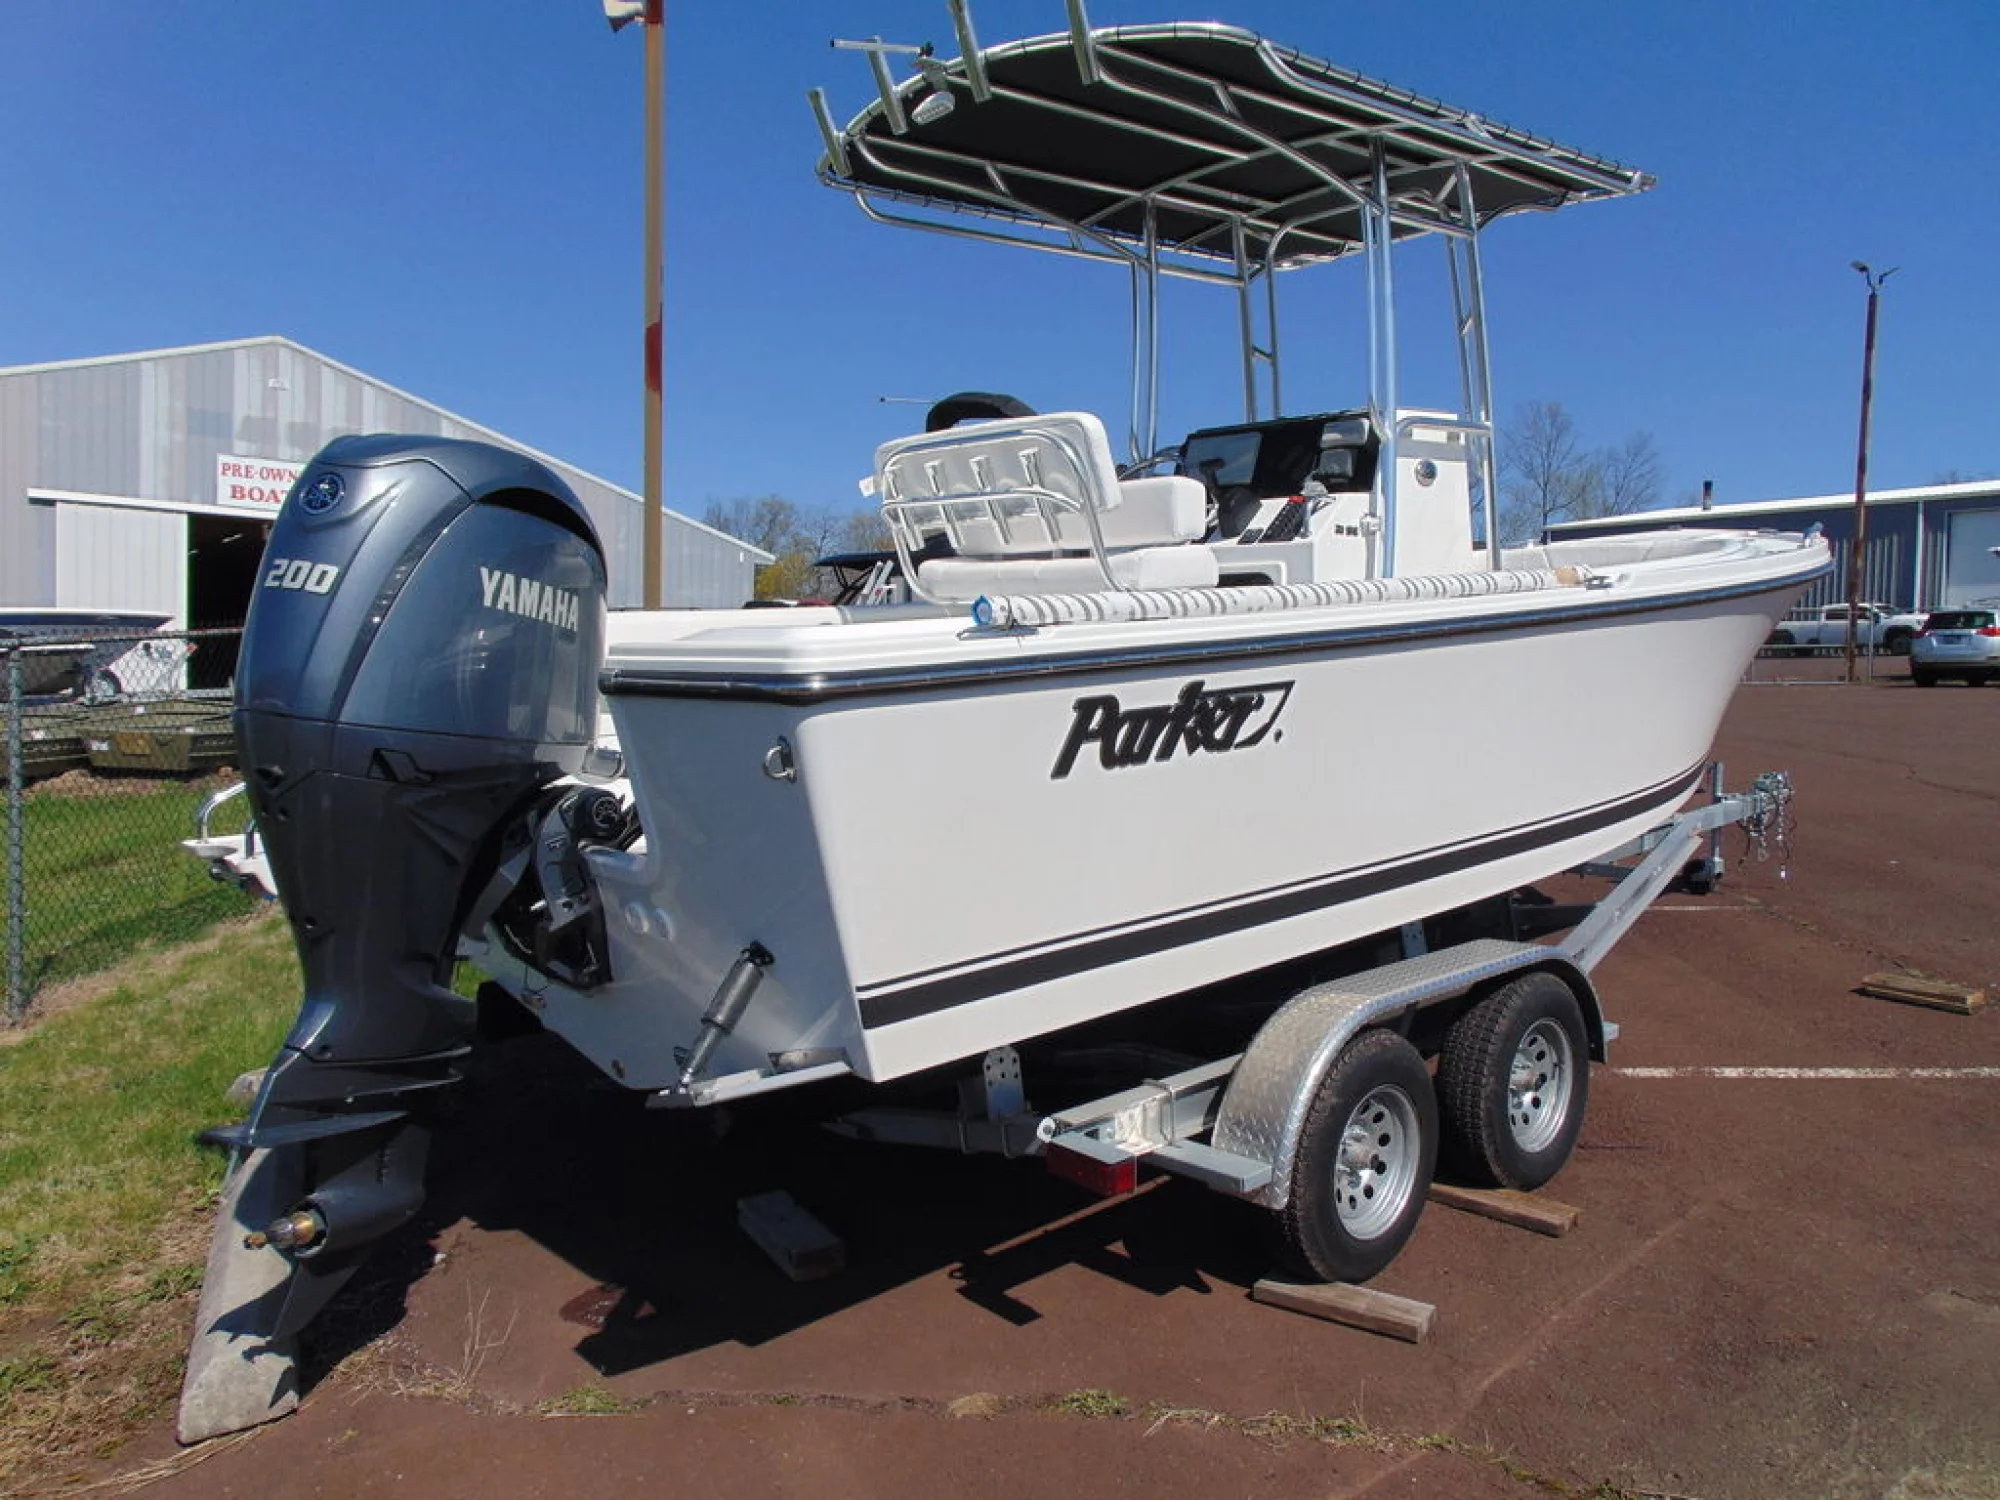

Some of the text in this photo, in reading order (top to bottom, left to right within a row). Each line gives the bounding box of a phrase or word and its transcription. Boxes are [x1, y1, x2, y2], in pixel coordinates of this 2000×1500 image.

[230, 484, 289, 504] BOA
[264, 559, 339, 595] 200
[479, 566, 579, 632] YAMAHA
[1050, 680, 1272, 779] Parker
